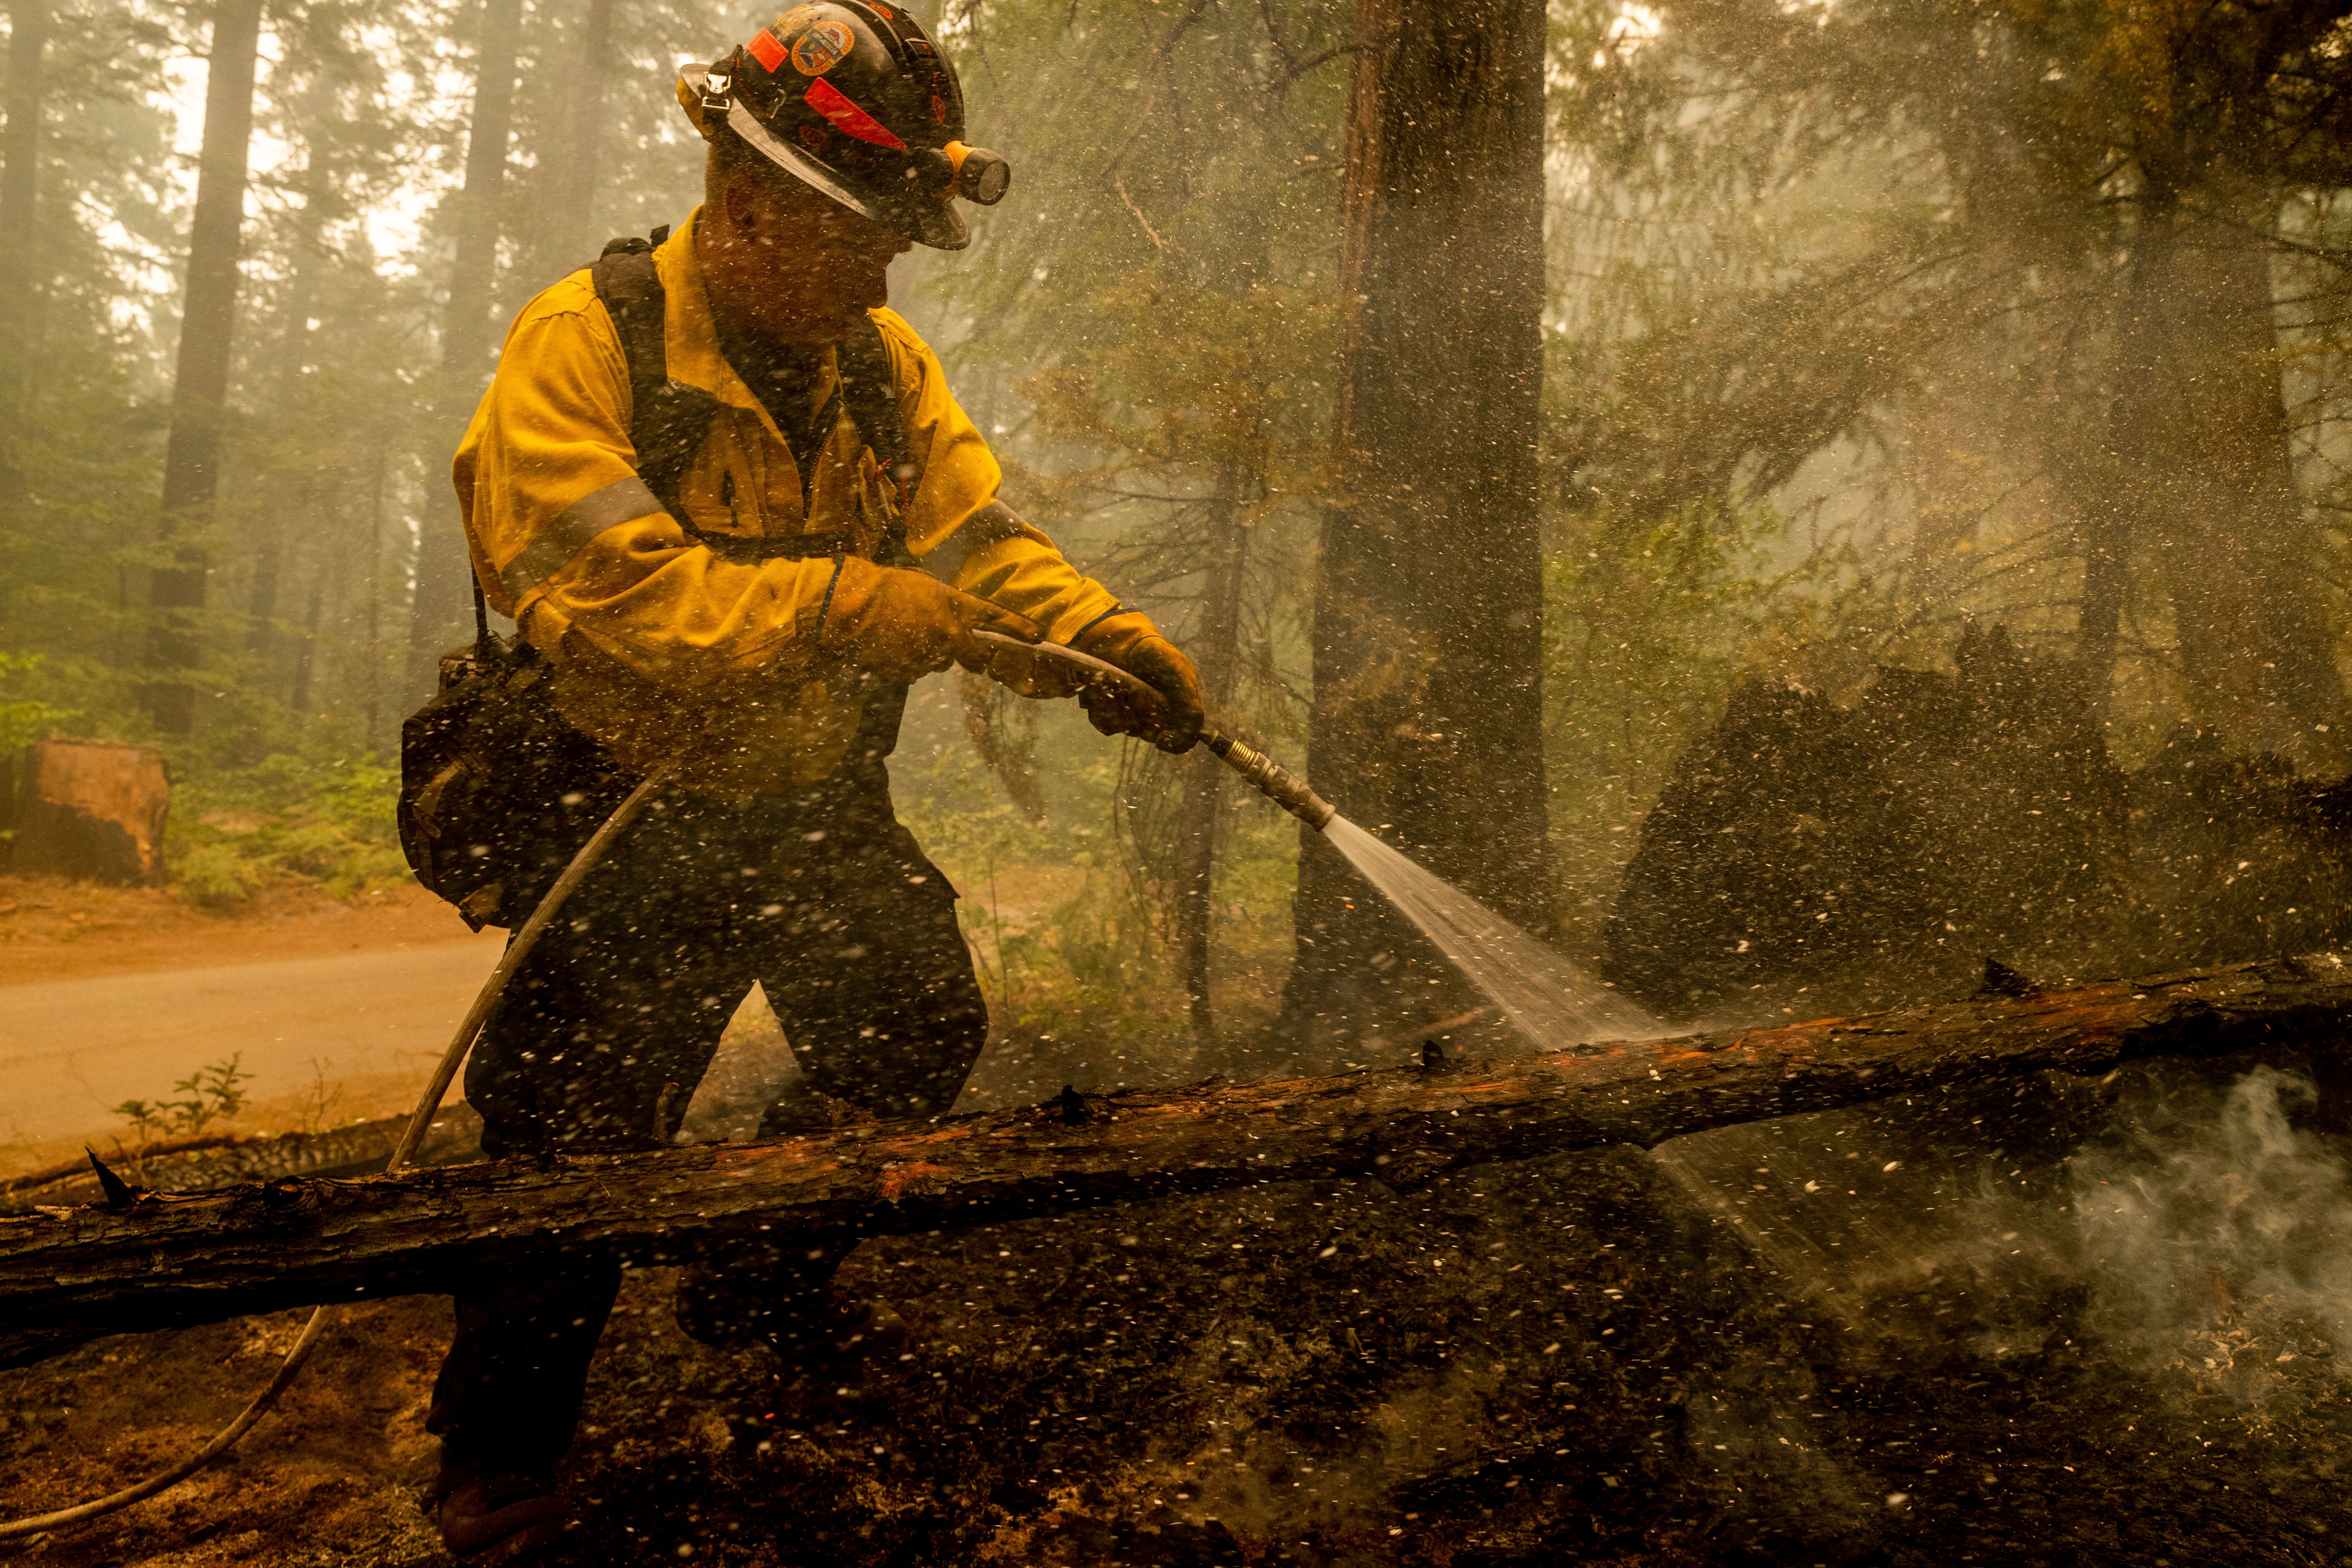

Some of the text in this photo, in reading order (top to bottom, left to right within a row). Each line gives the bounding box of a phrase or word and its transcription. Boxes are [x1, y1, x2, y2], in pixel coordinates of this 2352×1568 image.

[793, 37, 833, 74] PROTECTION DISTRICT
[821, 40, 838, 55] RESCUE
